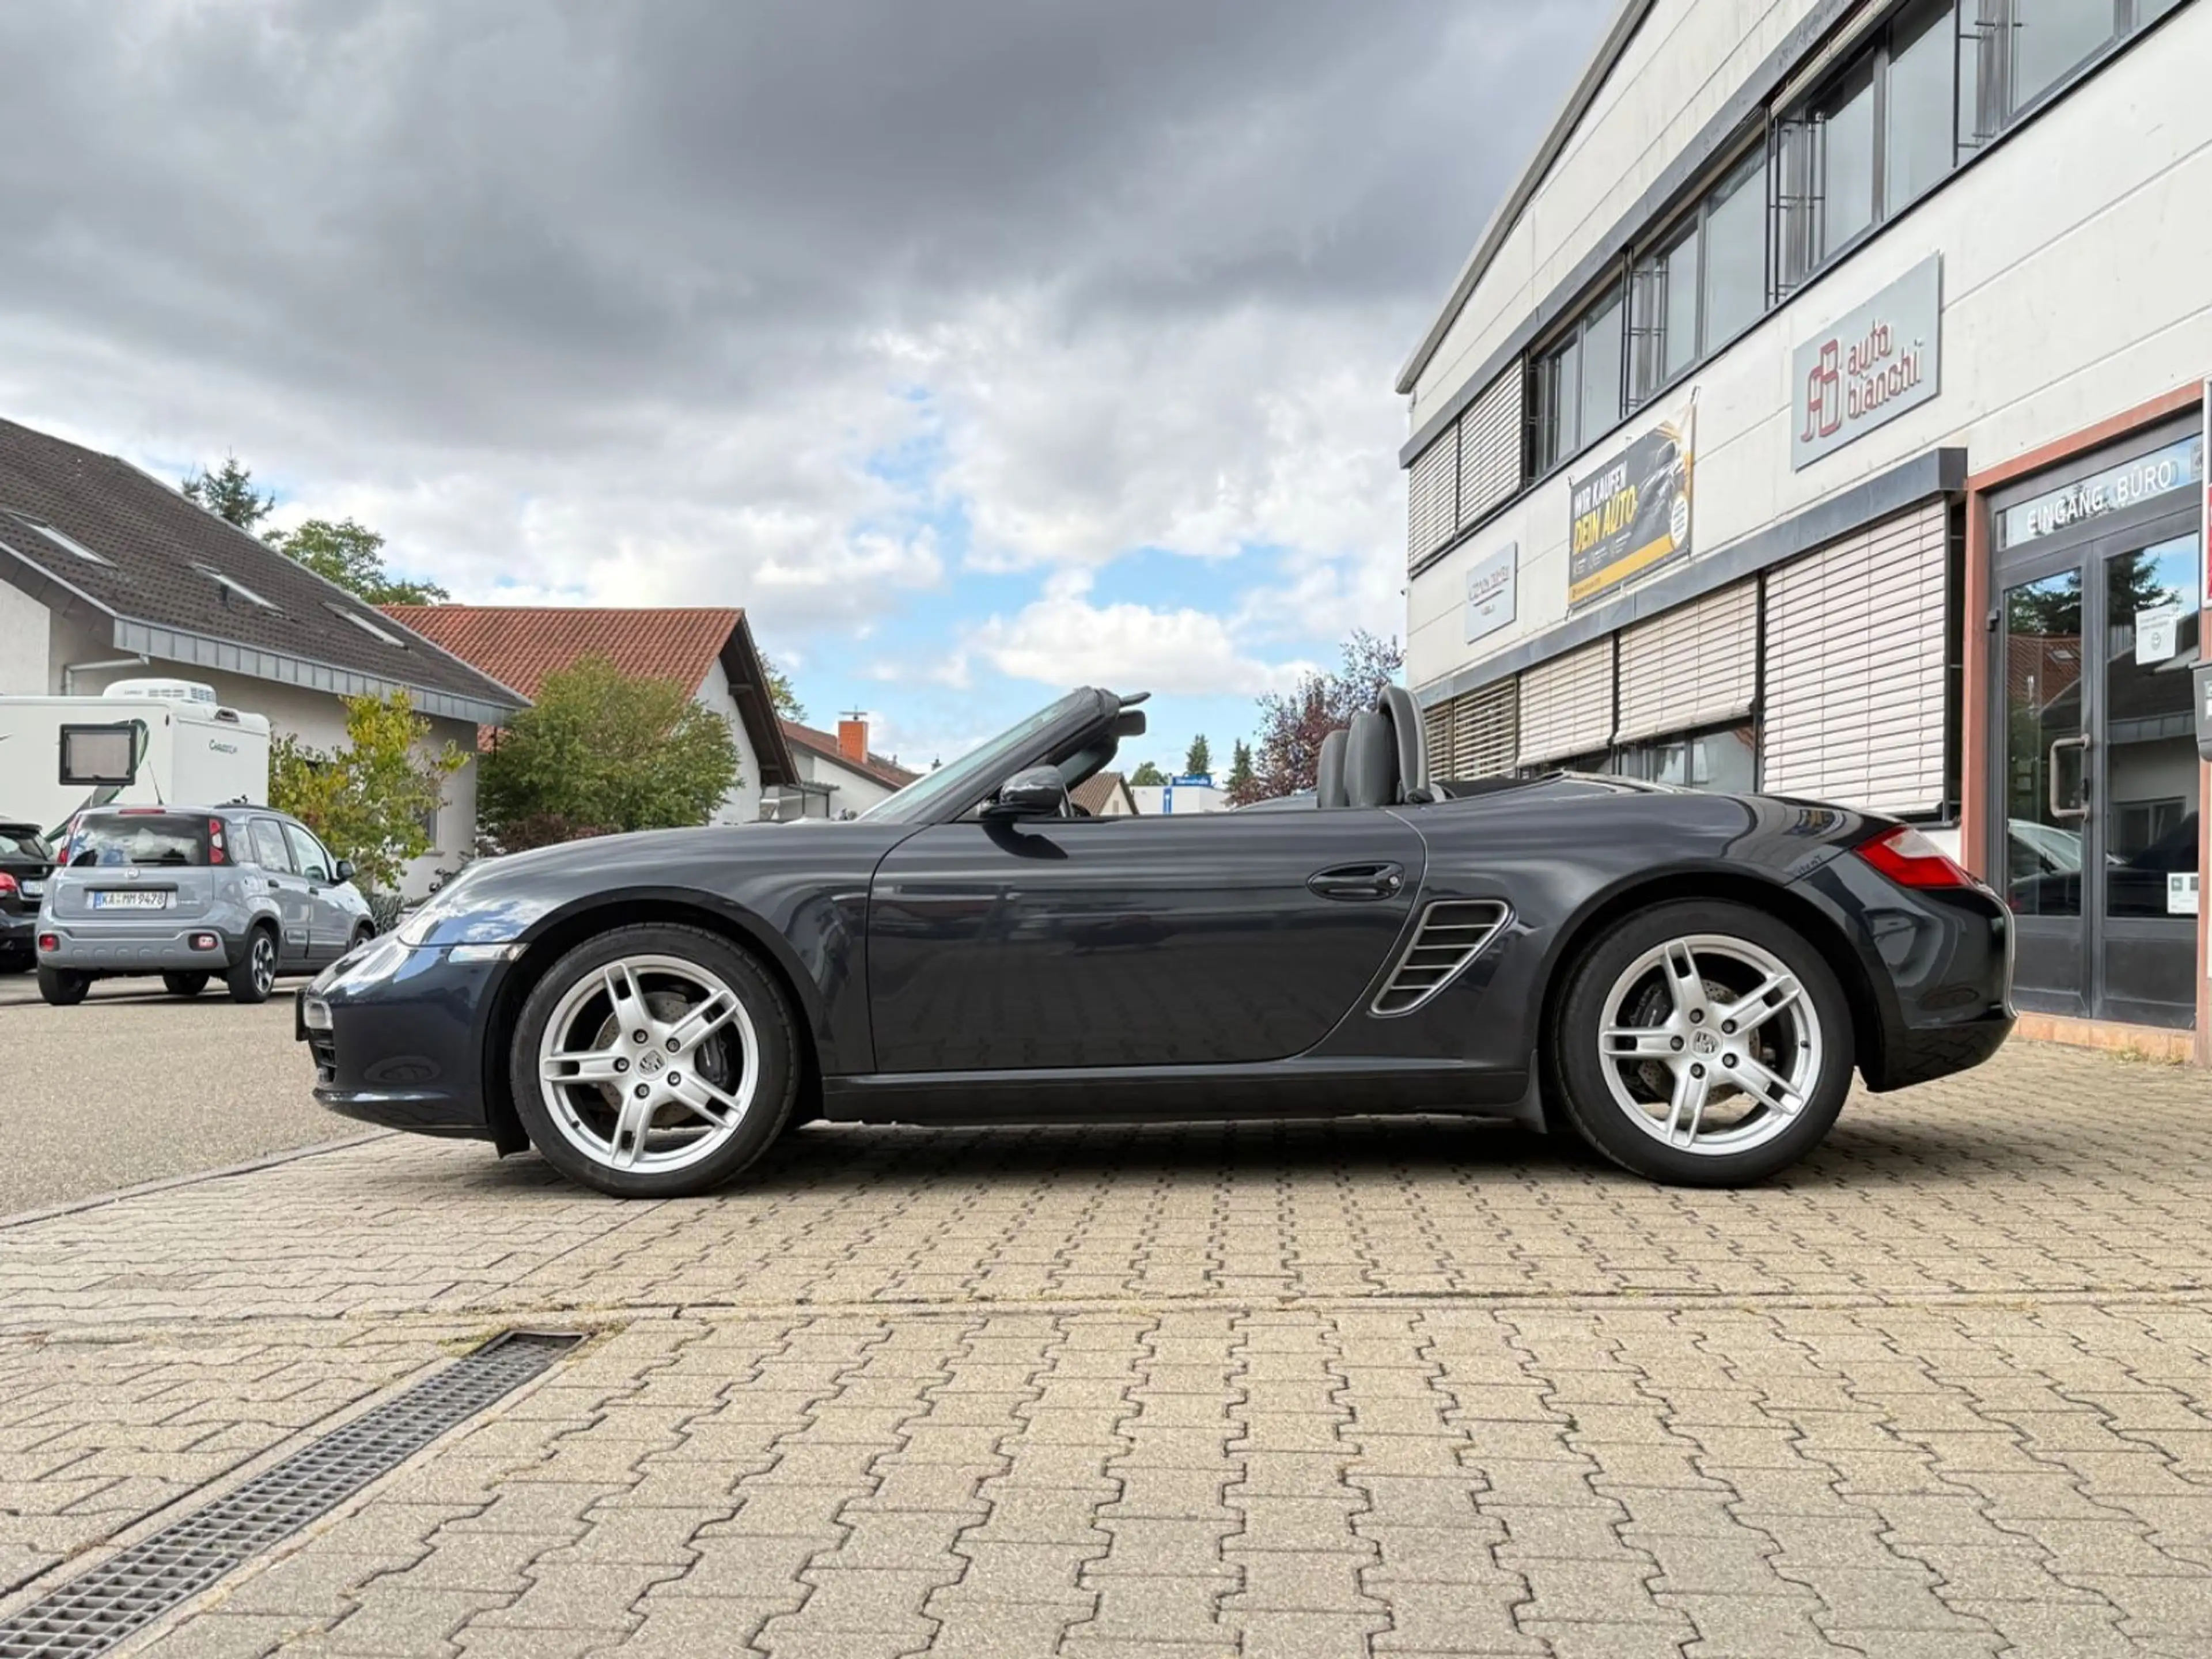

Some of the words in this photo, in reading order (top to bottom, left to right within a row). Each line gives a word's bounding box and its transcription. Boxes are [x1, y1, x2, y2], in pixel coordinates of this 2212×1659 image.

[1847, 318, 1892, 376] auto
[1847, 338, 1924, 419] bianchi
[1574, 486, 1592, 519] WIR
[2026, 486, 2103, 533] EINGANG
[2117, 460, 2172, 500] BÜRO
[1573, 506, 1601, 556] DEIN
